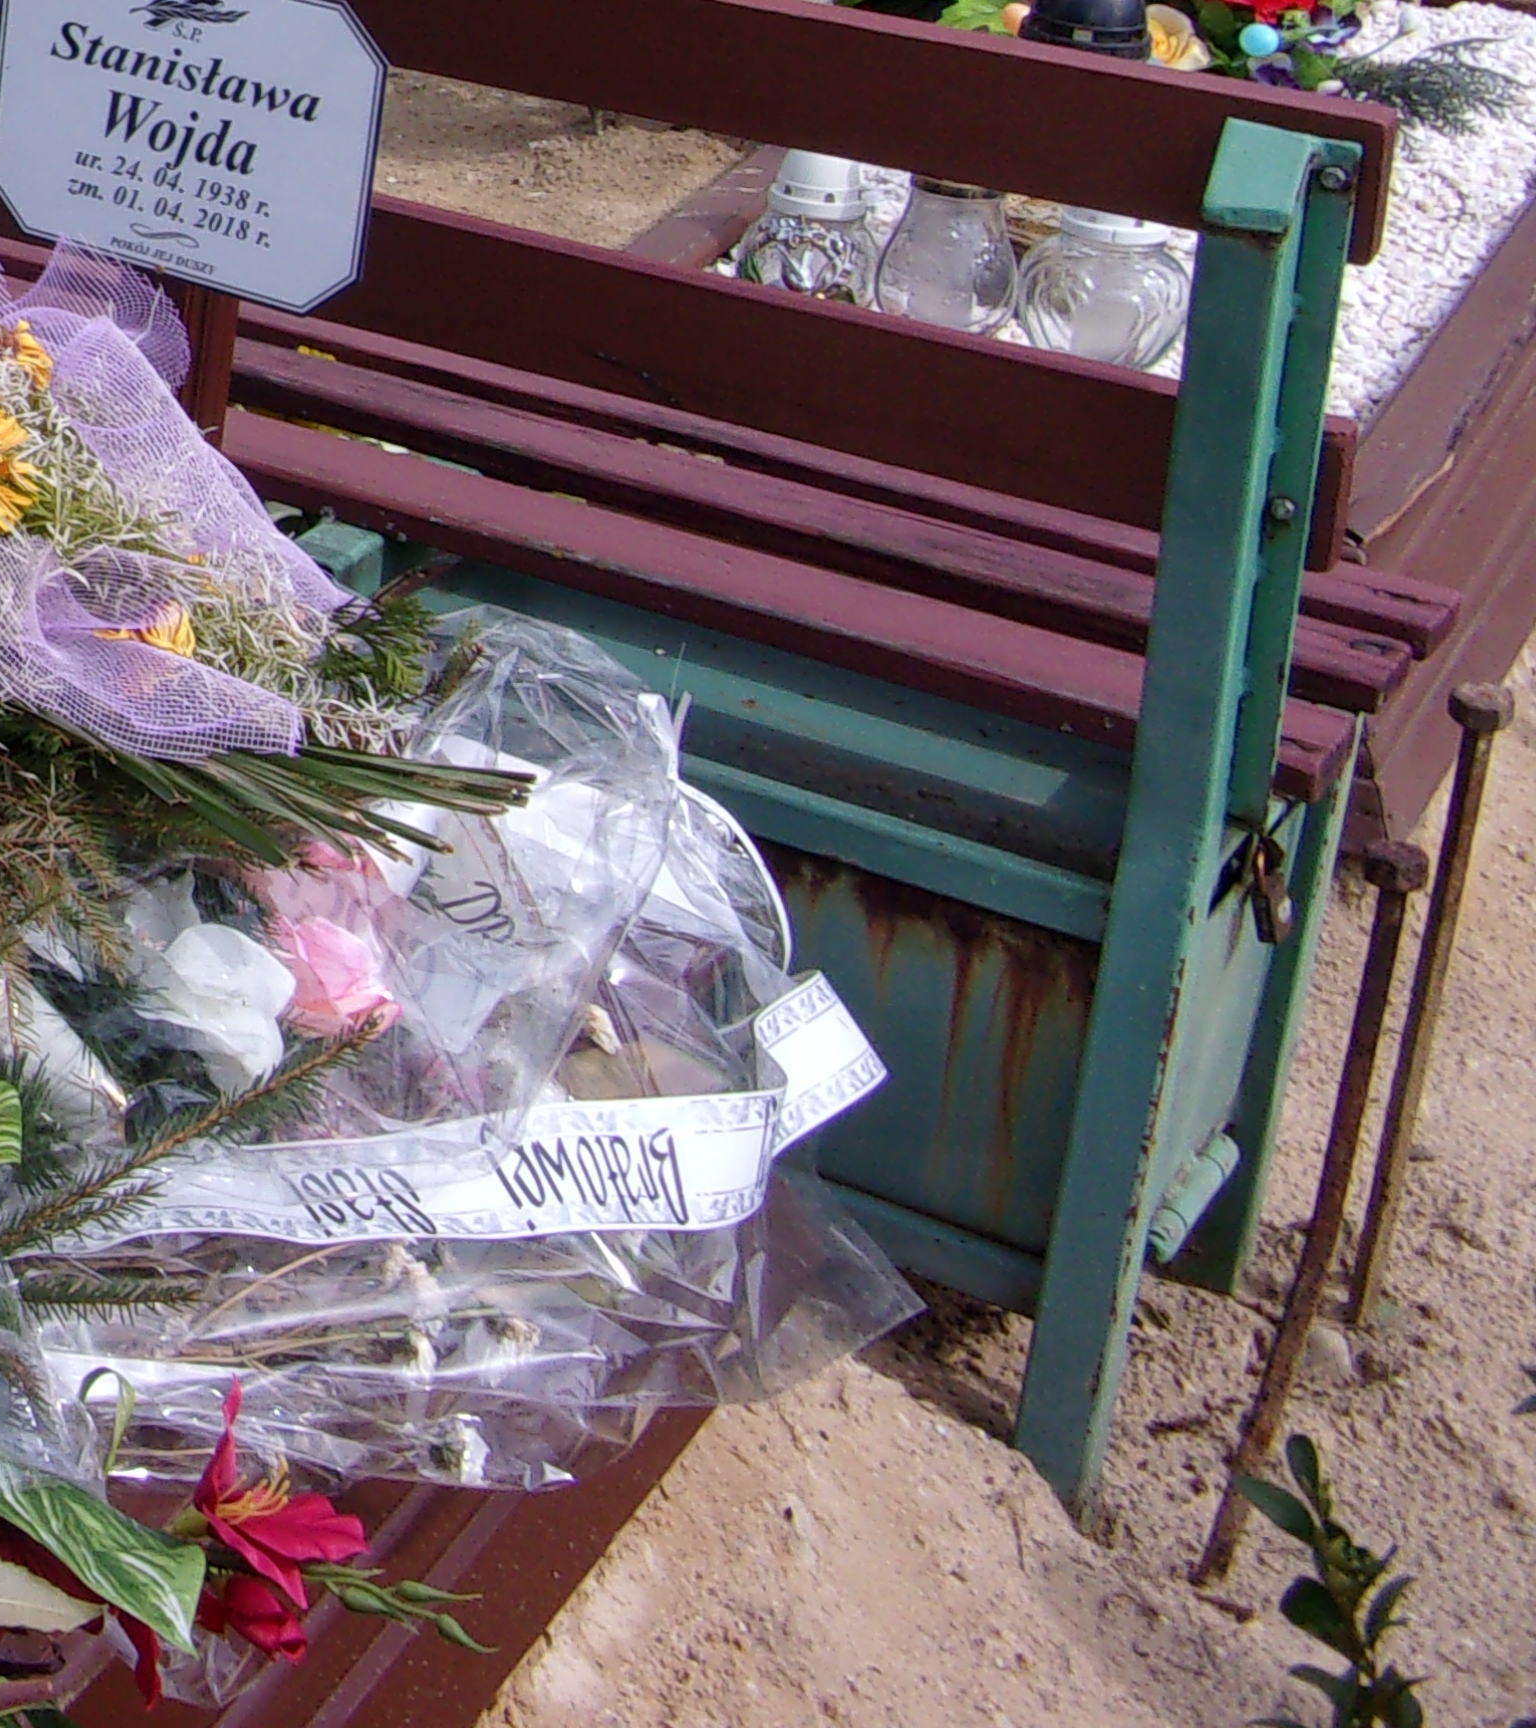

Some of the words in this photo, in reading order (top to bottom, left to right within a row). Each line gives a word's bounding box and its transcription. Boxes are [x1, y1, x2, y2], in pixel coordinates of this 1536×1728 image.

[49, 19, 323, 123] Stanisława
[103, 88, 258, 176] Wojda
[67, 177, 104, 201] zm.
[112, 185, 145, 213] 01.
[153, 196, 185, 224] 04.
[192, 207, 251, 242] 2018
[255, 230, 272, 249] r.
[75, 150, 103, 173] ur.
[111, 154, 144, 183] 24.
[152, 166, 185, 194] 04.
[194, 177, 251, 211] 1938
[255, 200, 271, 219] r.
[151, 247, 174, 264] JEJ
[175, 254, 217, 276] DUSZY
